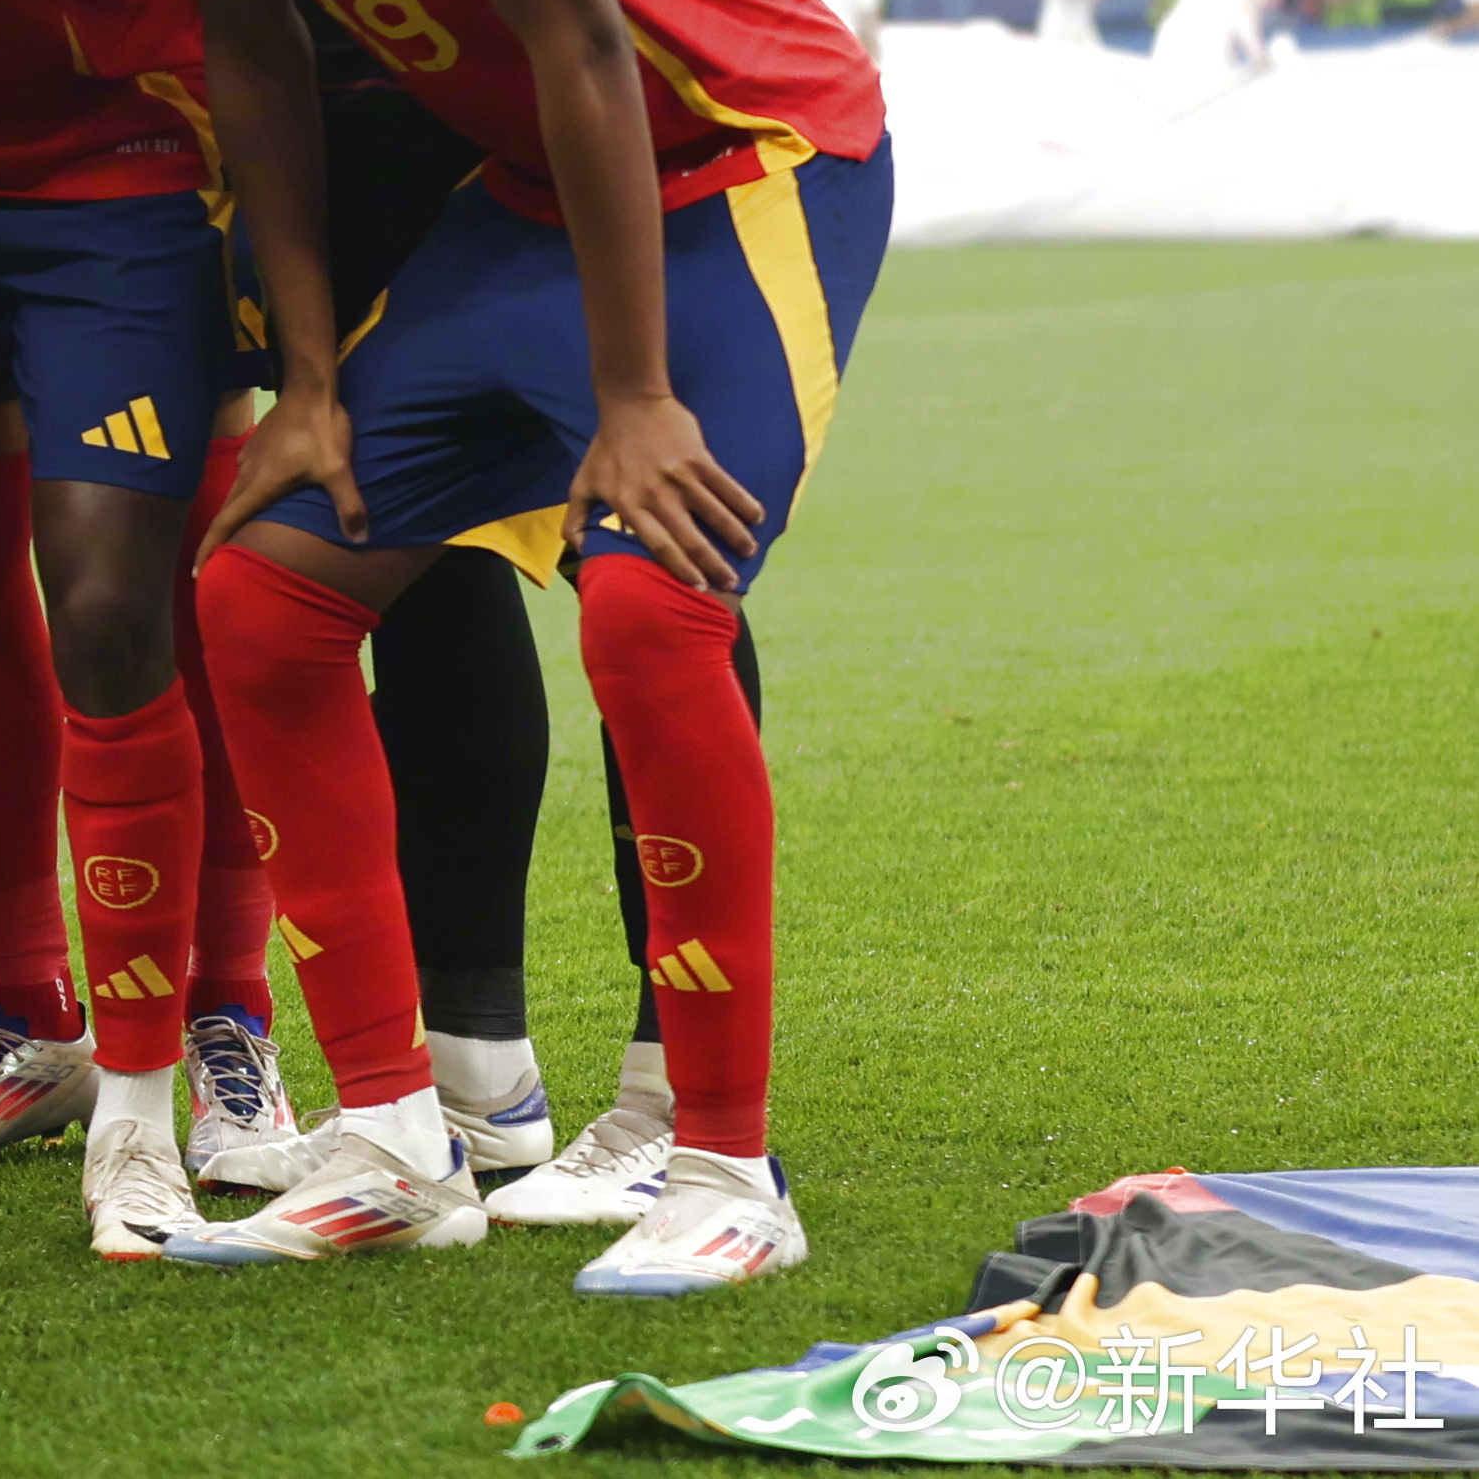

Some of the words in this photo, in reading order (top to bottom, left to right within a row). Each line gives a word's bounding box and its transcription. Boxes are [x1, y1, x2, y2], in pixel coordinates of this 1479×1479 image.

[96, 867, 137, 882] RF
[97, 882, 139, 897] EF
[22, 1061, 77, 1081] F50
[353, 1187, 439, 1224] F50
